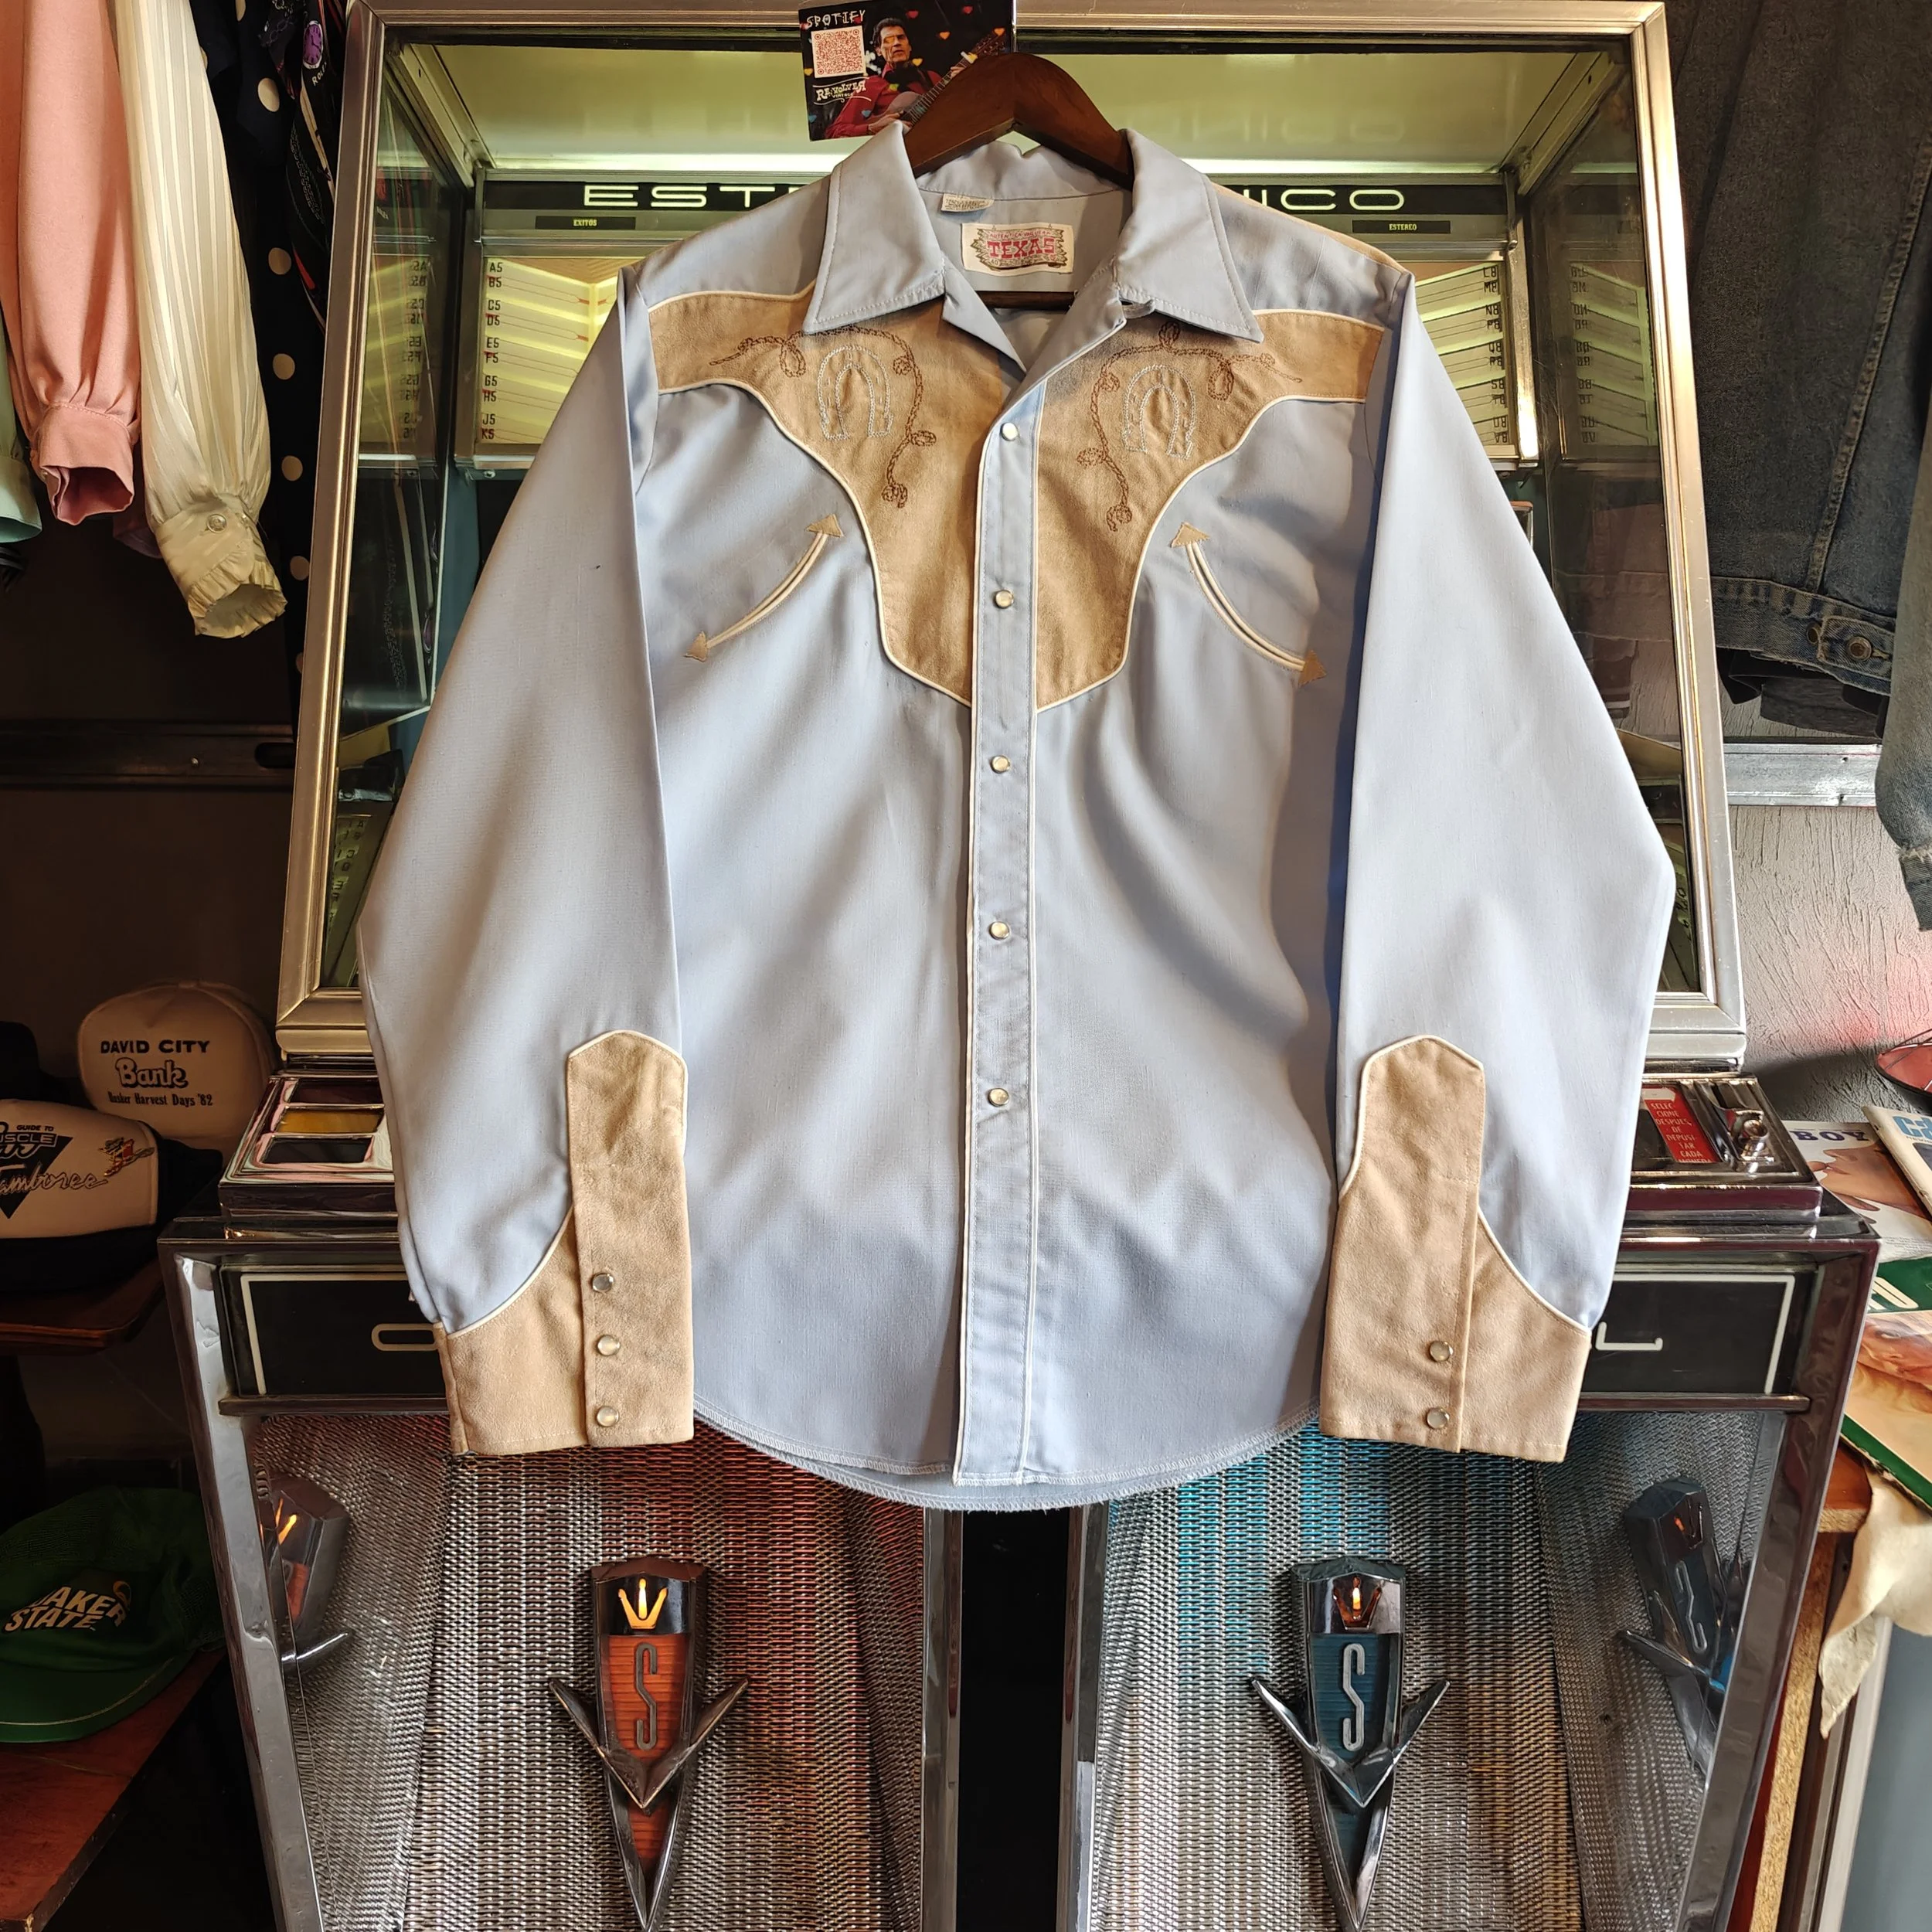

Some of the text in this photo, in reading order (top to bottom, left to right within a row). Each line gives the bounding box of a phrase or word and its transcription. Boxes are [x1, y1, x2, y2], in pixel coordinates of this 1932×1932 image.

[806, 10, 866, 28] SPOTIFY
[584, 185, 800, 208] EST
[1243, 189, 1404, 210] ICO
[987, 236, 1056, 259] TEXAS
[489, 262, 502, 273] A5
[488, 300, 501, 311] C5
[487, 315, 500, 326] D5
[486, 337, 499, 348] E5
[485, 375, 497, 386] G5
[482, 413, 495, 425] J5
[100, 1039, 210, 1053] DAVID CITY
[115, 1056, 189, 1089] Bank
[134, 1093, 168, 1105] Harvest
[172, 1094, 196, 1107] Days
[197, 1094, 213, 1106] '82
[28, 1587, 128, 1628] AKER
[5, 1606, 104, 1632] STATE
[634, 1642, 658, 1750] S
[1342, 1643, 1366, 1751] S
